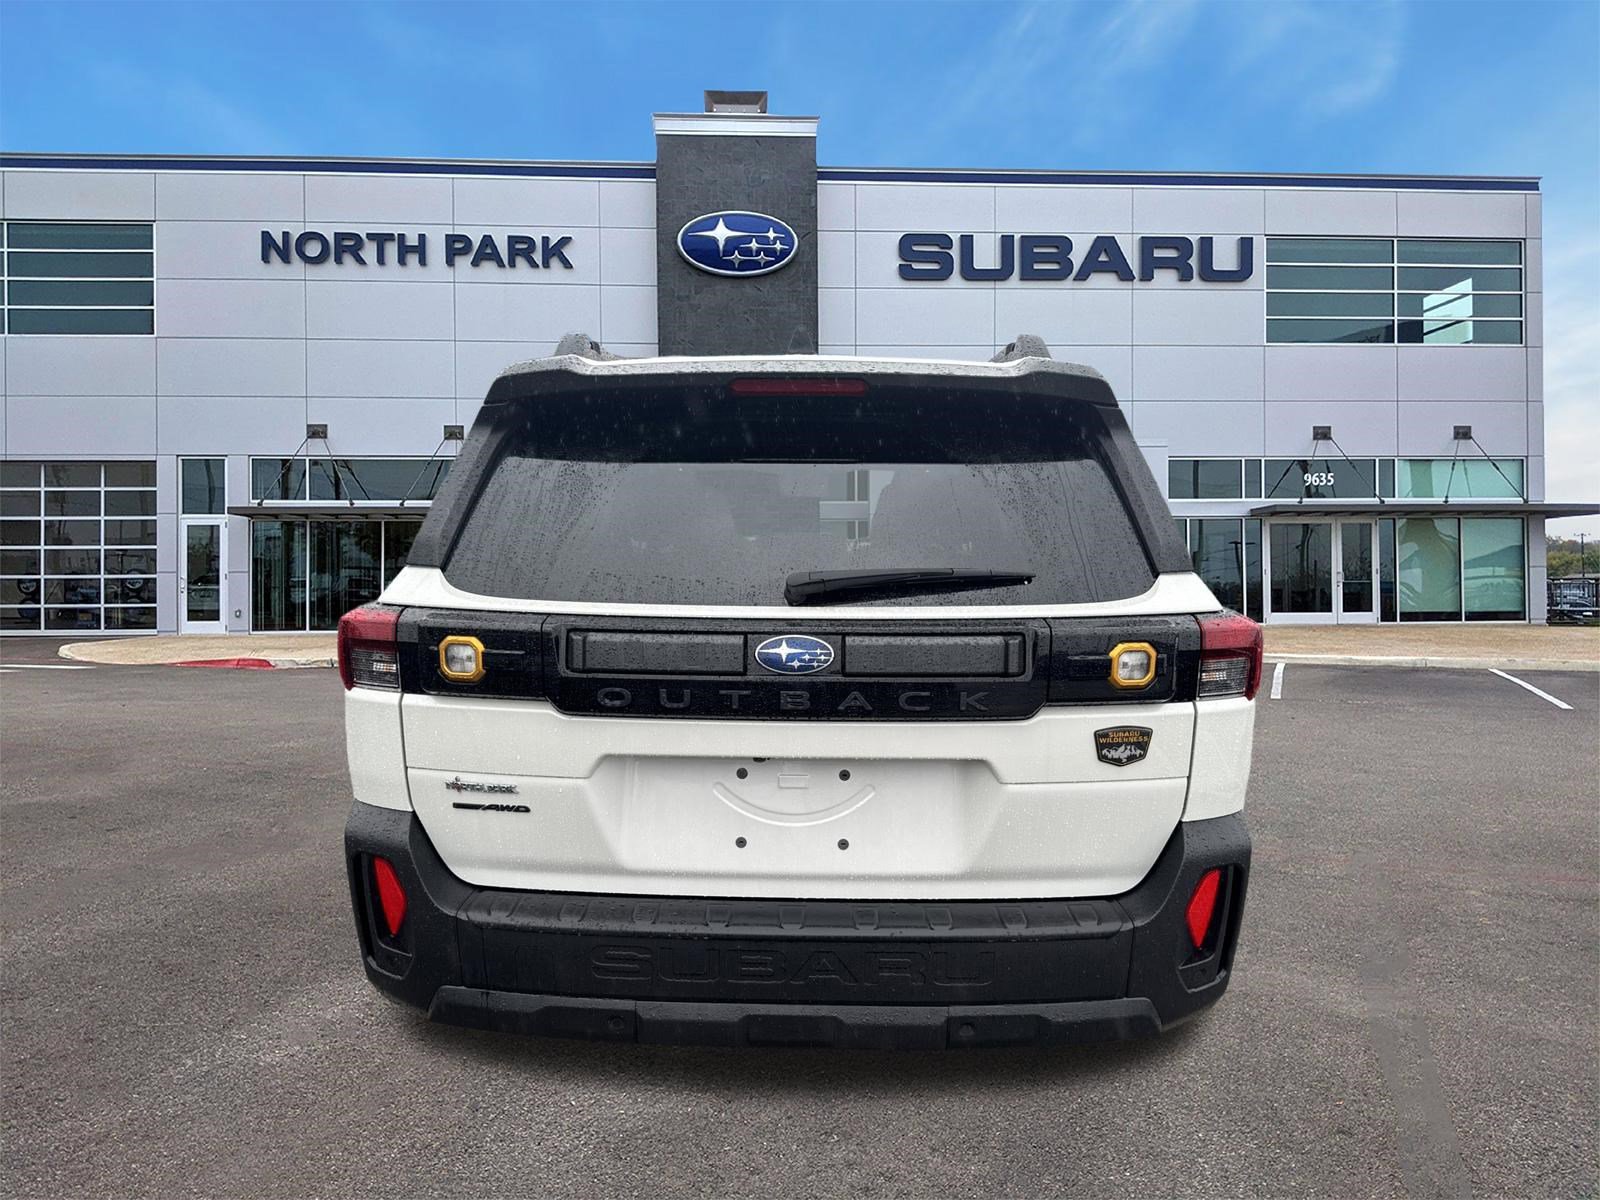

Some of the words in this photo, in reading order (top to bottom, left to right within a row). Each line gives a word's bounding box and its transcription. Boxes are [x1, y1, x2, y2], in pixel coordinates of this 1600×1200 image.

[260, 230, 427, 267] NORTH
[445, 234, 576, 270] PARK
[898, 233, 1254, 282] SUBARU
[1303, 473, 1335, 486] 9635
[598, 687, 990, 711] OUTBACK
[1099, 735, 1149, 744] WILDERNESS
[1108, 730, 1140, 738] SUBARU
[481, 803, 531, 813] AWD
[591, 945, 996, 986] SUBARU
